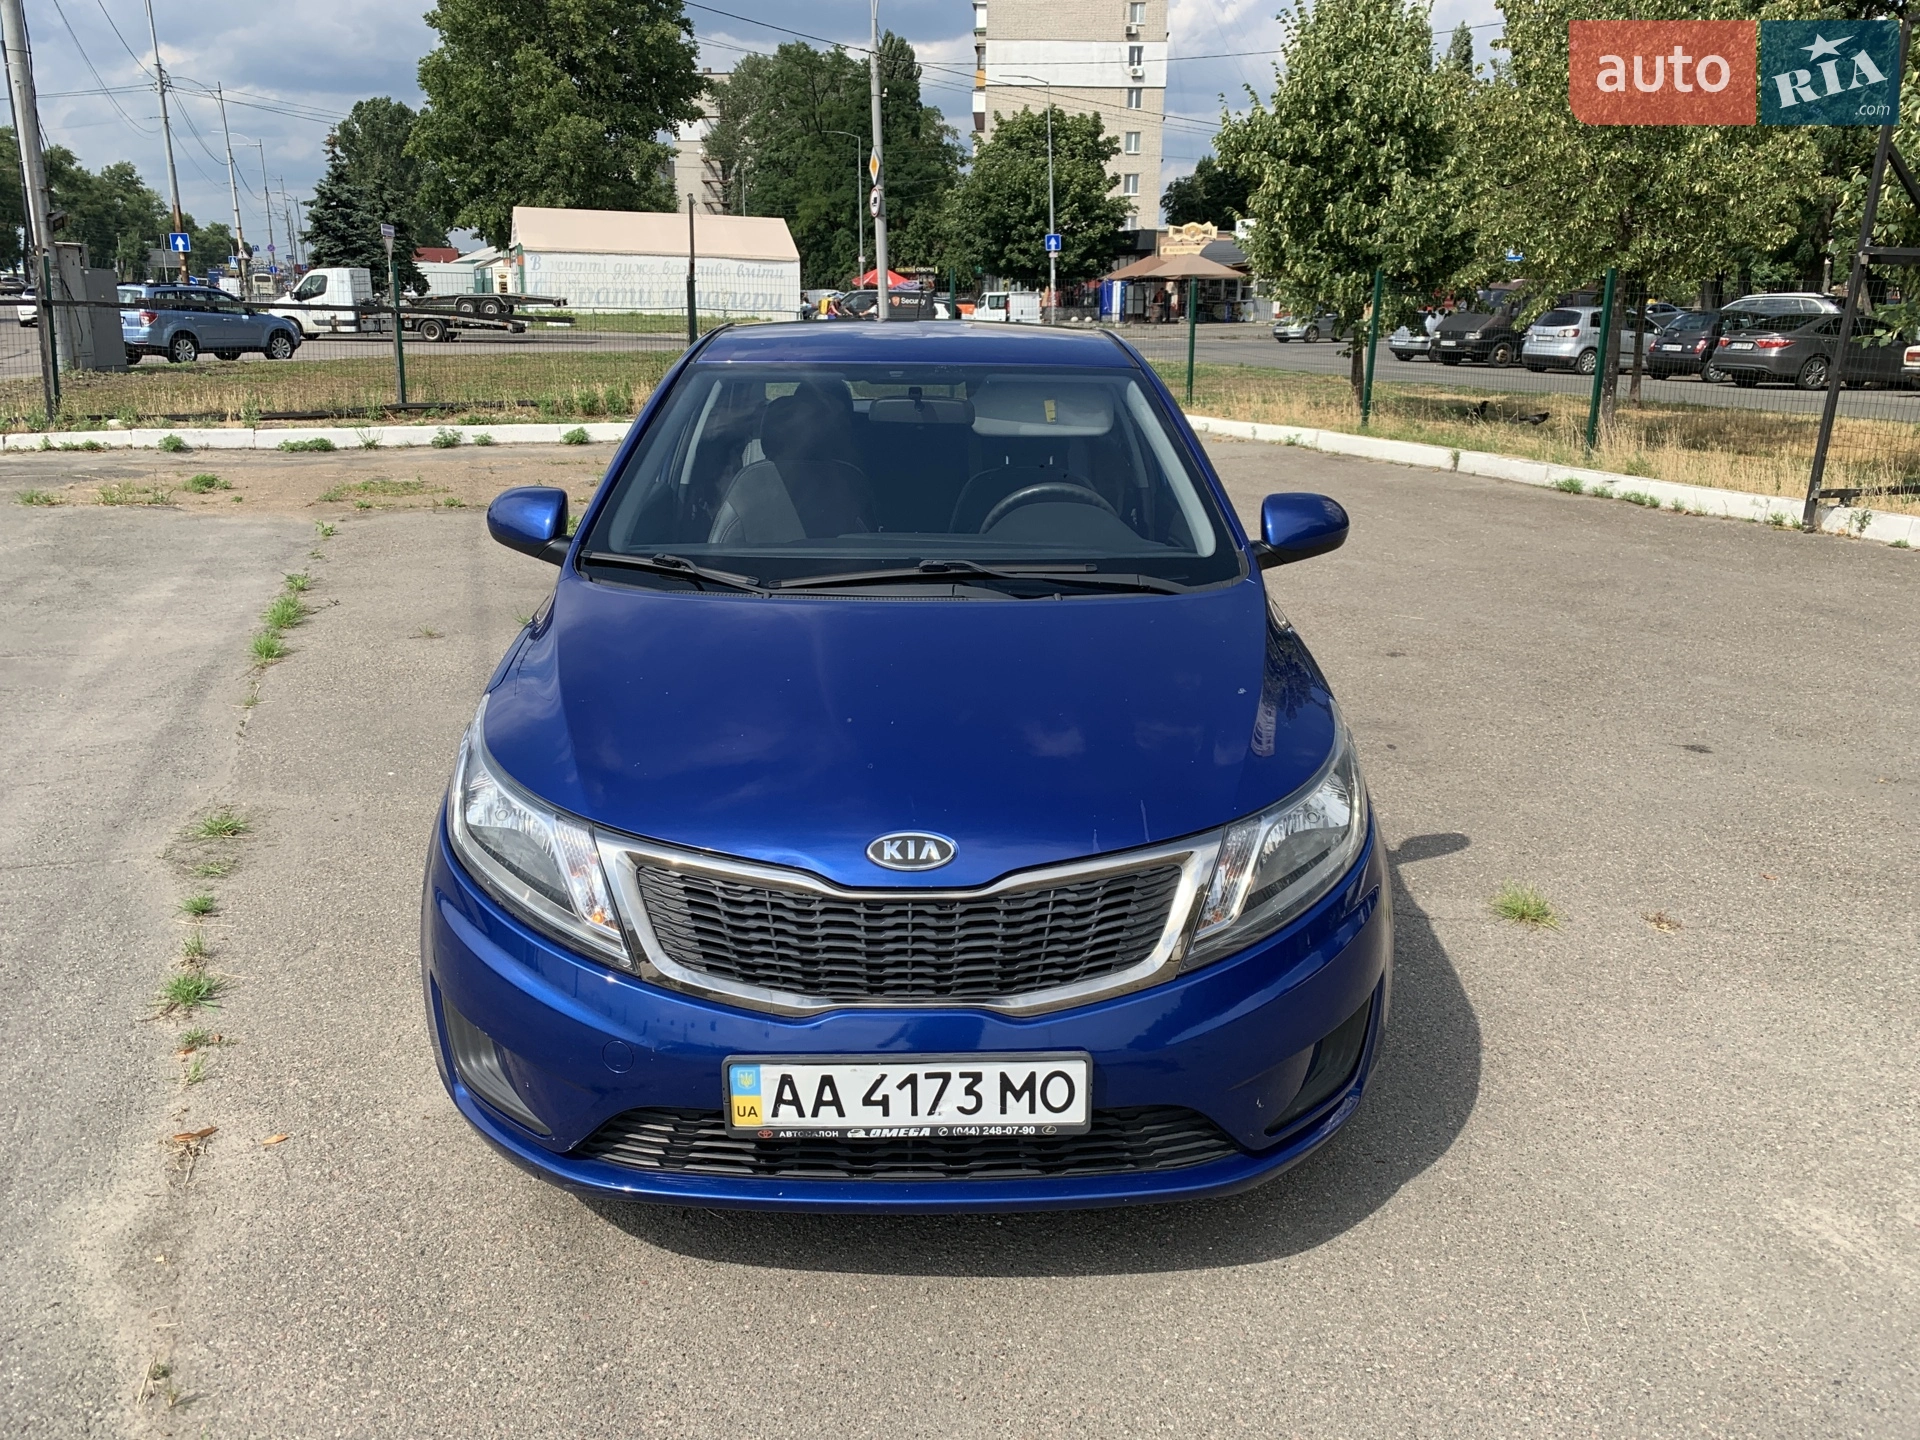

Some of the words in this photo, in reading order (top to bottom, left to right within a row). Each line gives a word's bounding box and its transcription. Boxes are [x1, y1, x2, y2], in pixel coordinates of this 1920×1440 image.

[736, 263, 785, 279] вміти
[883, 840, 941, 860] KIA
[737, 1105, 759, 1118] UA
[770, 1073, 846, 1118] AA
[861, 1071, 984, 1117] 4173
[999, 1069, 1076, 1115] MO
[870, 1127, 931, 1138] OMEGA
[982, 1126, 1036, 1136] 248-07-90
